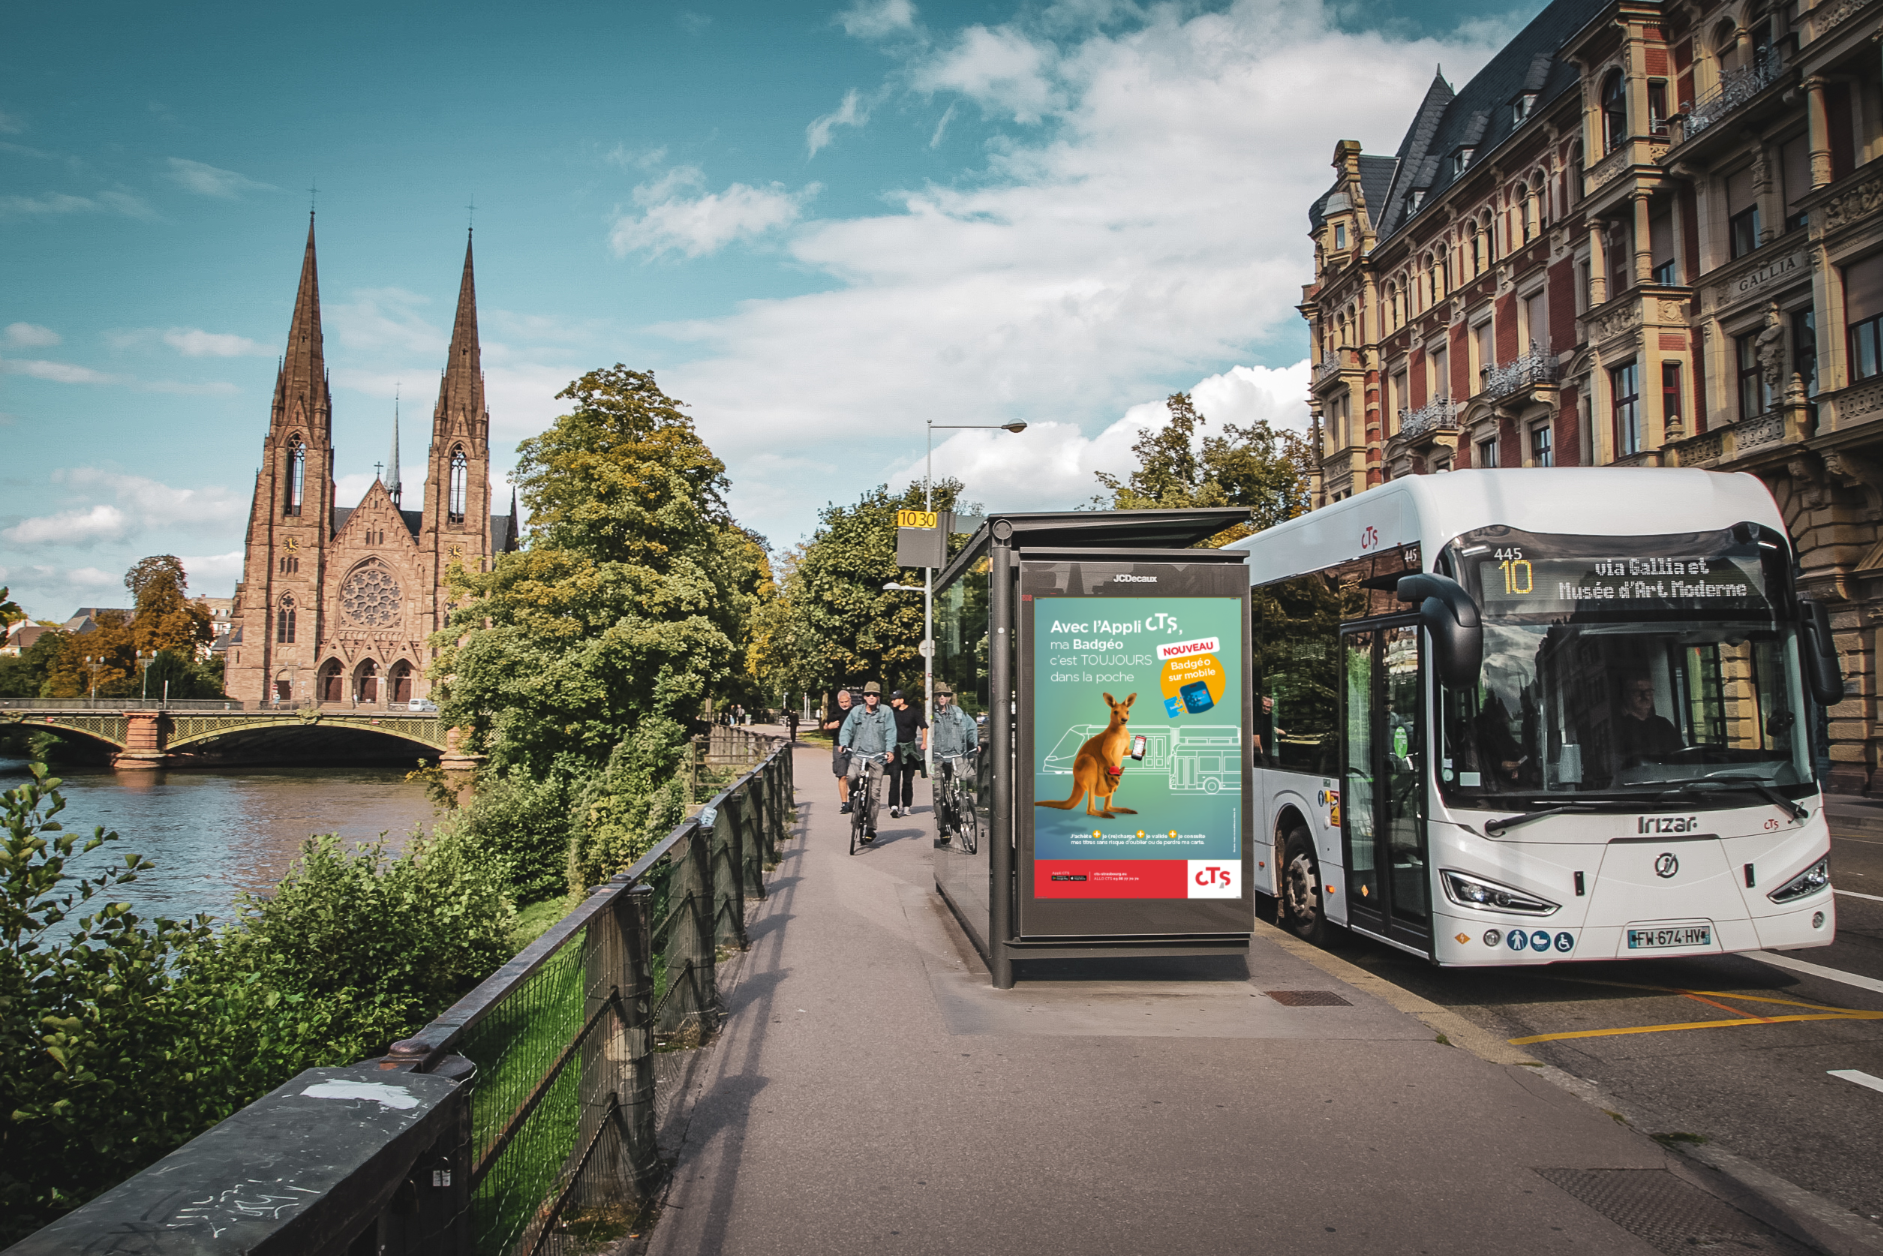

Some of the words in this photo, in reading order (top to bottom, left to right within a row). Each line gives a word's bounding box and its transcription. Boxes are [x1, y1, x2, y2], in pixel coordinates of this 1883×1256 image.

[1739, 257, 1796, 292] GALLIA
[900, 511, 917, 526] 10
[918, 512, 936, 527] 30
[1404, 548, 1418, 563] 445
[1494, 547, 1523, 560] 445
[1595, 558, 1625, 576] via
[1629, 557, 1685, 575] Gallia
[1688, 556, 1710, 575] et
[1113, 574, 1158, 583] JCDecaux
[1499, 559, 1534, 595] 10
[1559, 581, 1615, 600] Musée
[1619, 579, 1668, 599] d'Art
[1671, 580, 1748, 598] Moderne
[1050, 619, 1089, 634] Avec
[1093, 619, 1142, 636] l'Appli
[1050, 641, 1070, 650] ma
[1073, 638, 1124, 652] Badgéo
[1163, 641, 1214, 656] NOUVEAU
[1049, 654, 1078, 666] c'est
[1080, 654, 1153, 666] TOUJOURS
[1170, 657, 1211, 671] Badgéo
[1050, 671, 1080, 682] dans
[1082, 671, 1093, 682] la
[1095, 671, 1135, 684] poche
[1168, 673, 1182, 682] sur
[1184, 668, 1216, 680] mobile
[1637, 929, 1701, 946] FW-674-HV
